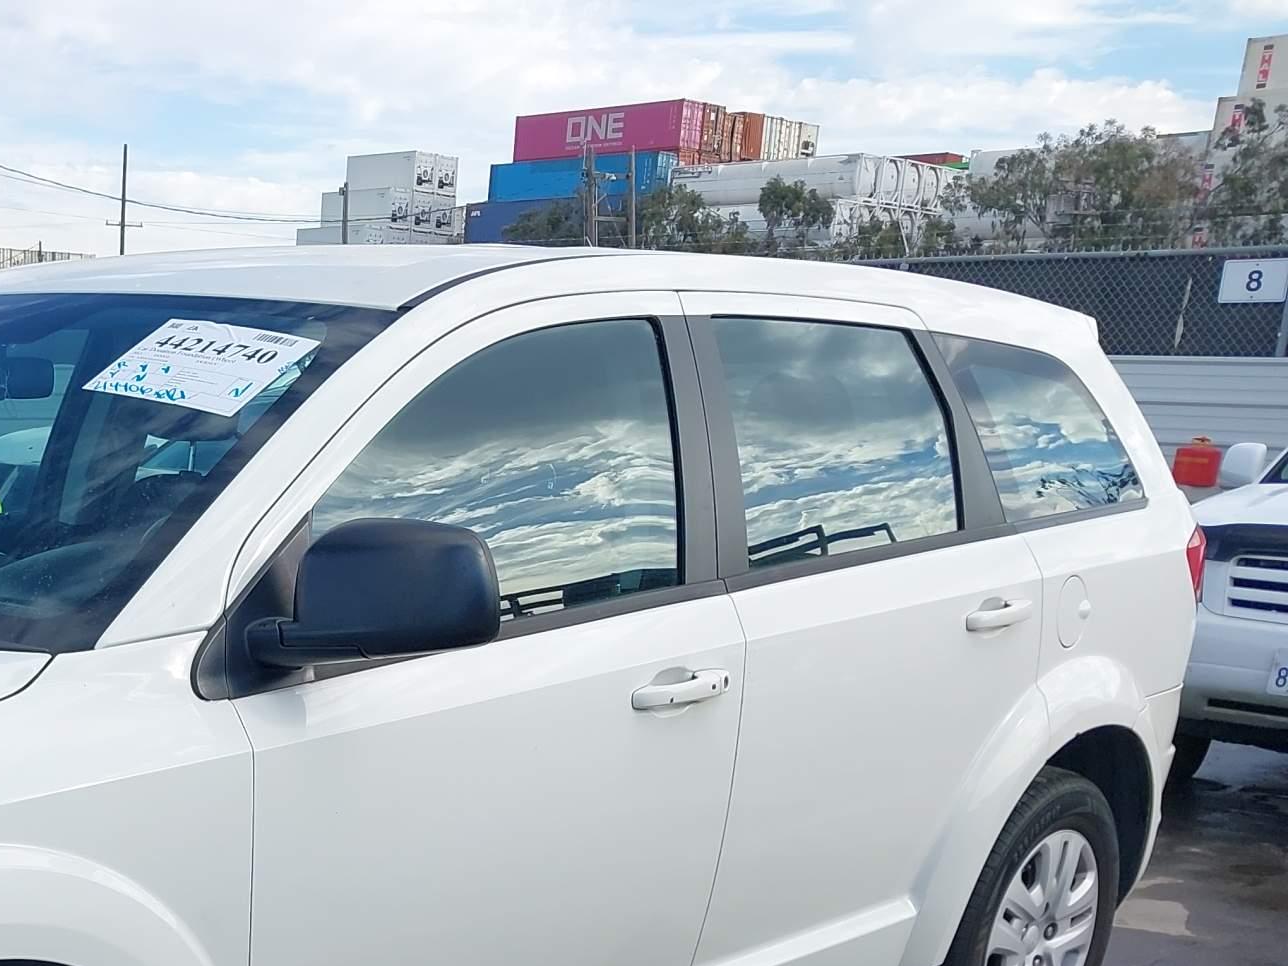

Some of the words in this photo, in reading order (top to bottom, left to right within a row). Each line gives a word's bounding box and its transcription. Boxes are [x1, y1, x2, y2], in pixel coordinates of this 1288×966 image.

[566, 112, 624, 143] ONE
[1246, 270, 1263, 291] 8
[155, 335, 278, 364] 44214740
